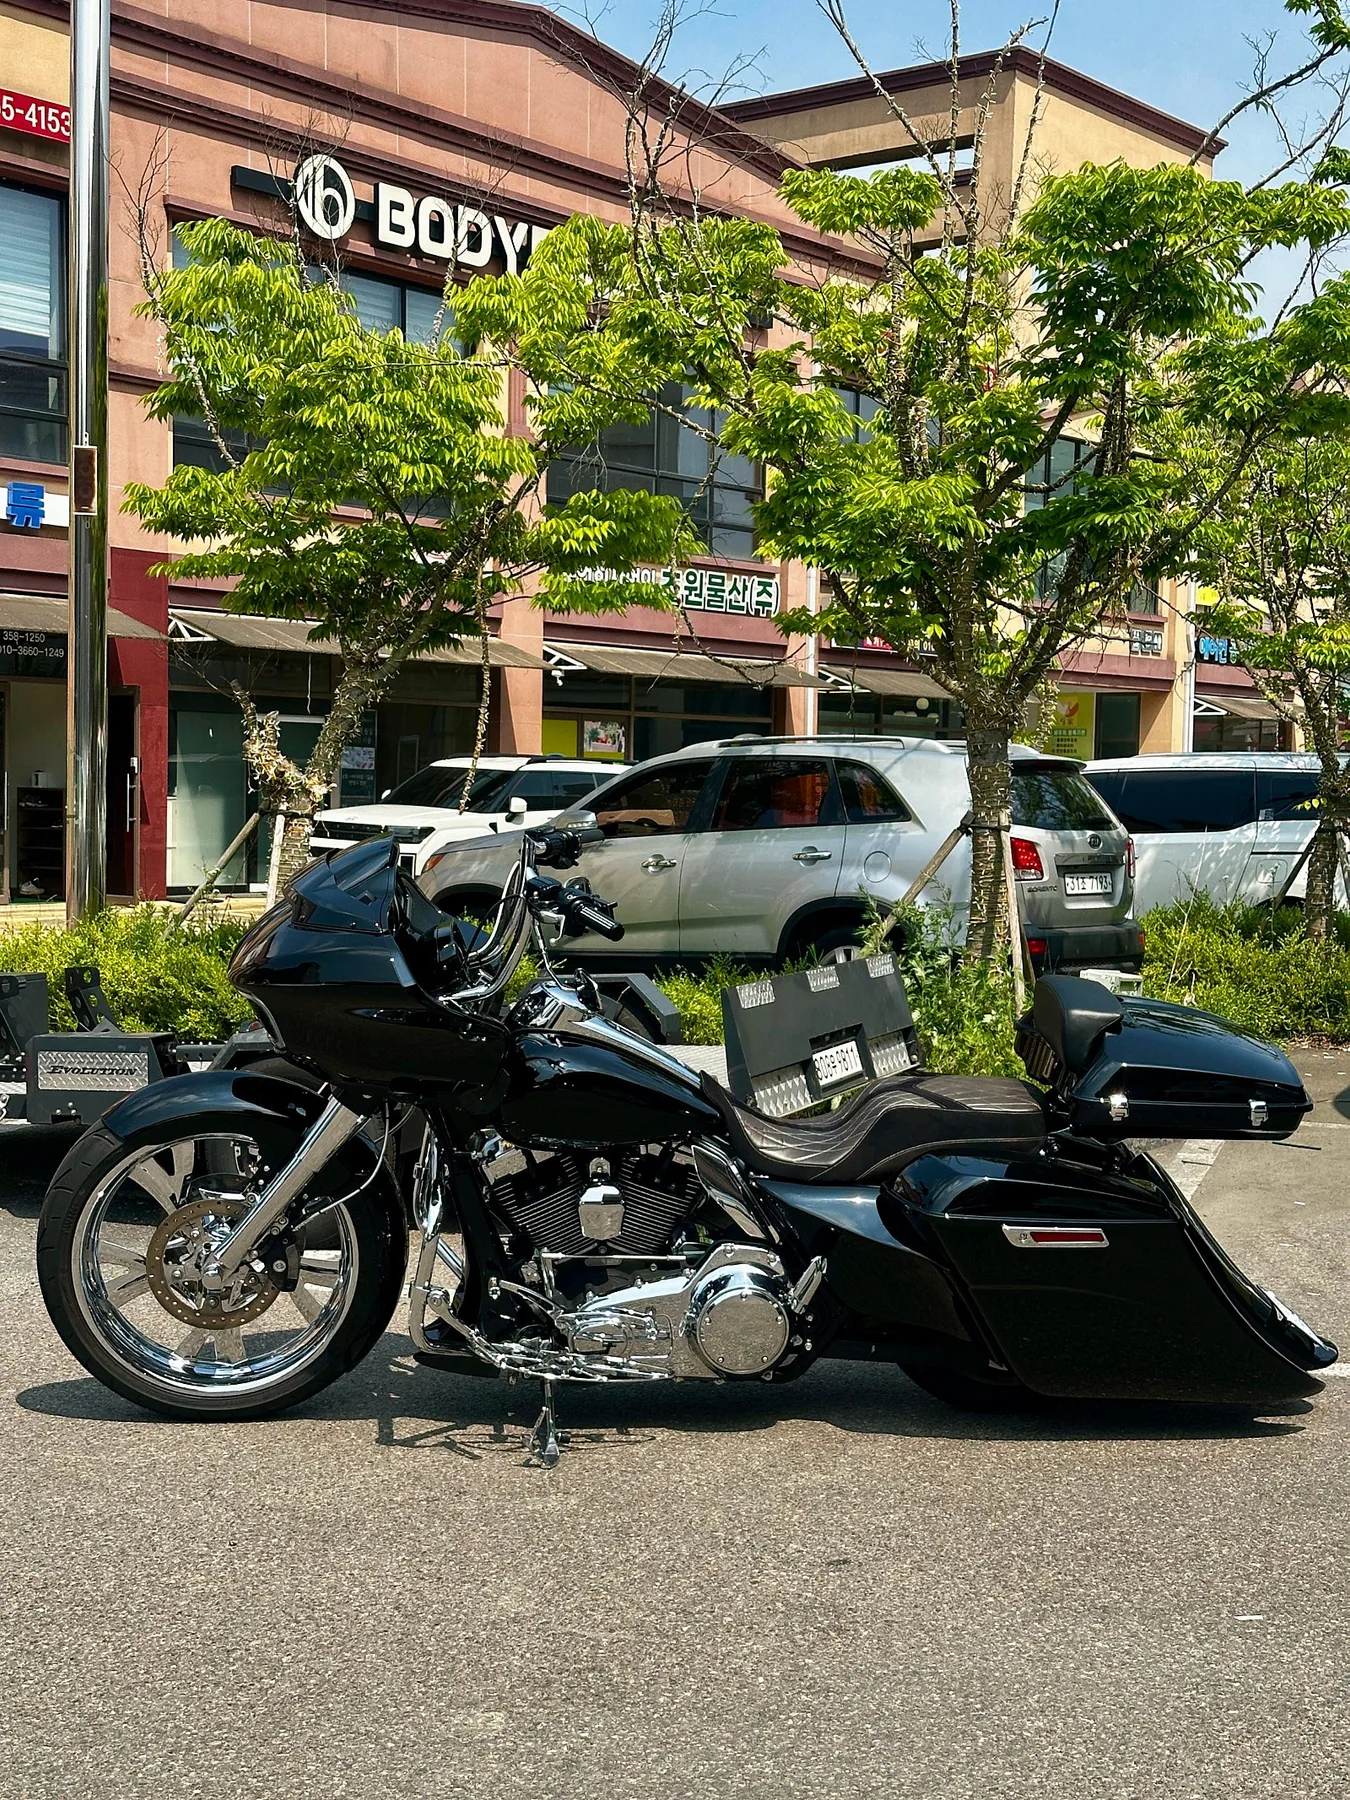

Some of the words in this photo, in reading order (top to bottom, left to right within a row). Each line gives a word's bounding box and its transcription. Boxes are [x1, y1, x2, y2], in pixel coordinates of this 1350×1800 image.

[0, 95, 70, 136] 5-4153
[6, 482, 45, 529] 류
[3, 631, 46, 643] 358-1250
[1089, 875, 1108, 891] 7193
